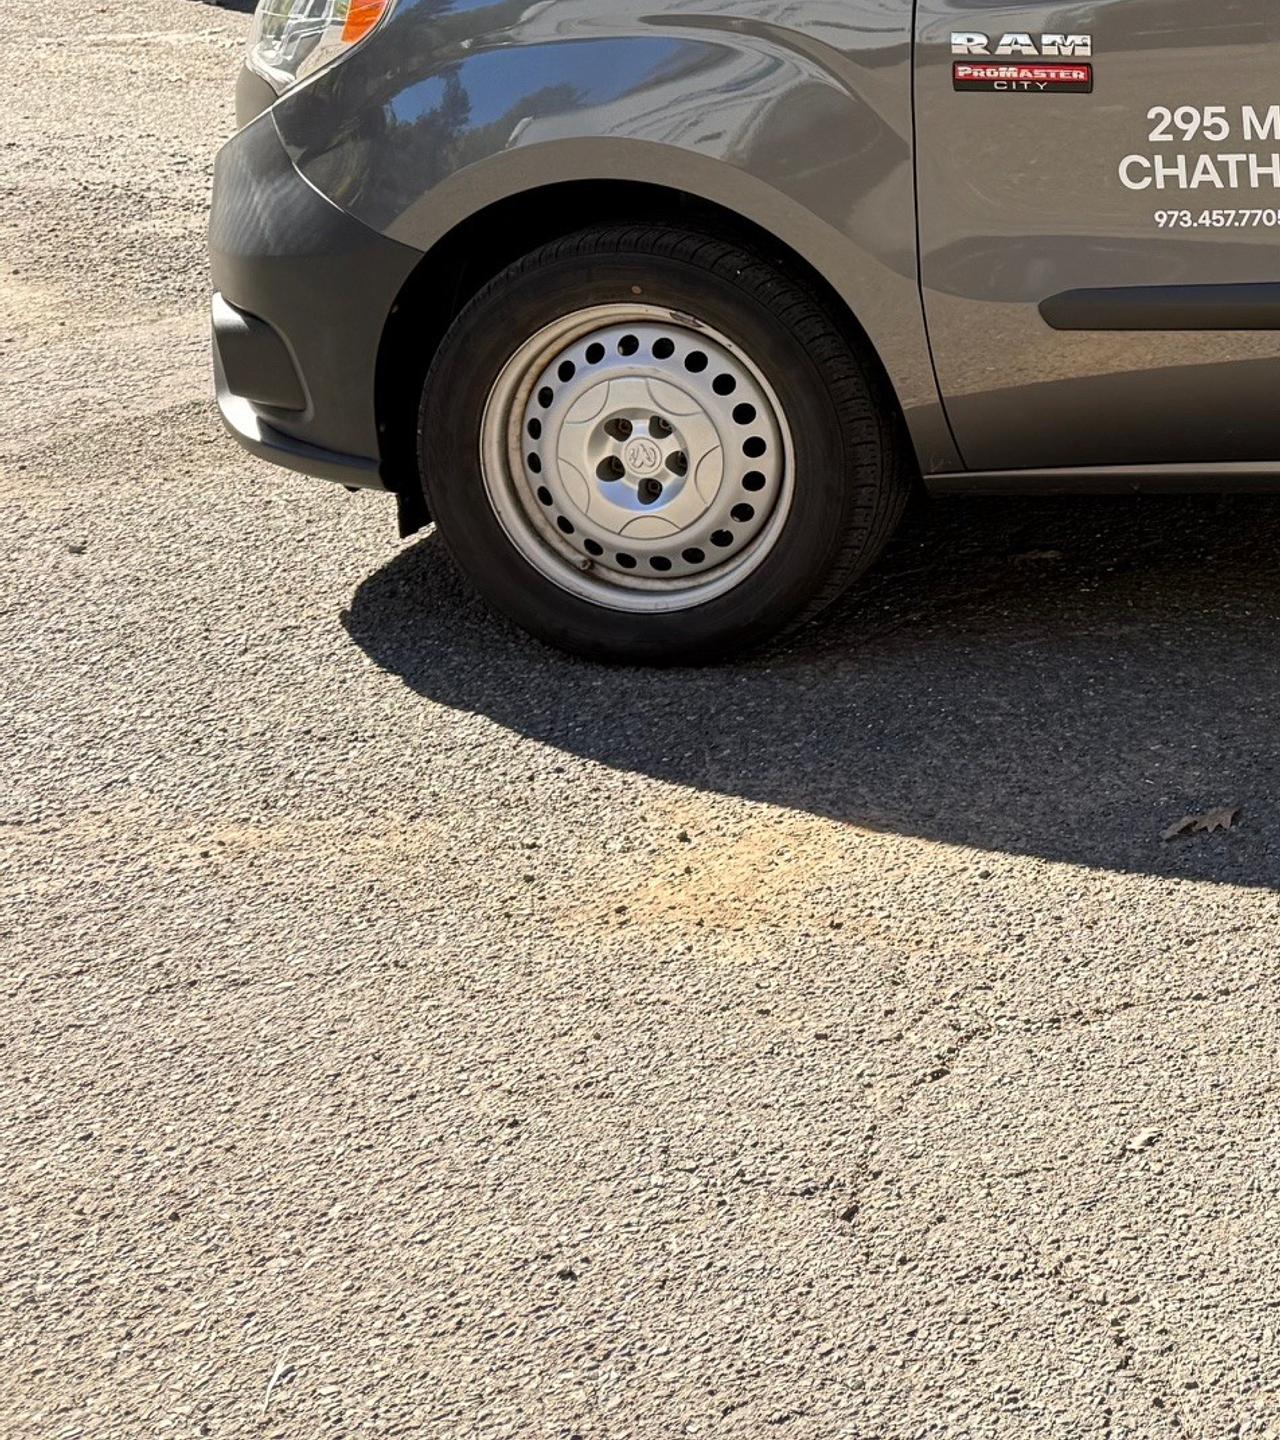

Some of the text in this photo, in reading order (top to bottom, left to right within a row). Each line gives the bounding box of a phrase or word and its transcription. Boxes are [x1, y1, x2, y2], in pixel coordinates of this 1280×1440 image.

[951, 32, 1092, 57] RAM
[993, 81, 1048, 90] CITY
[1146, 106, 1231, 142] 295
